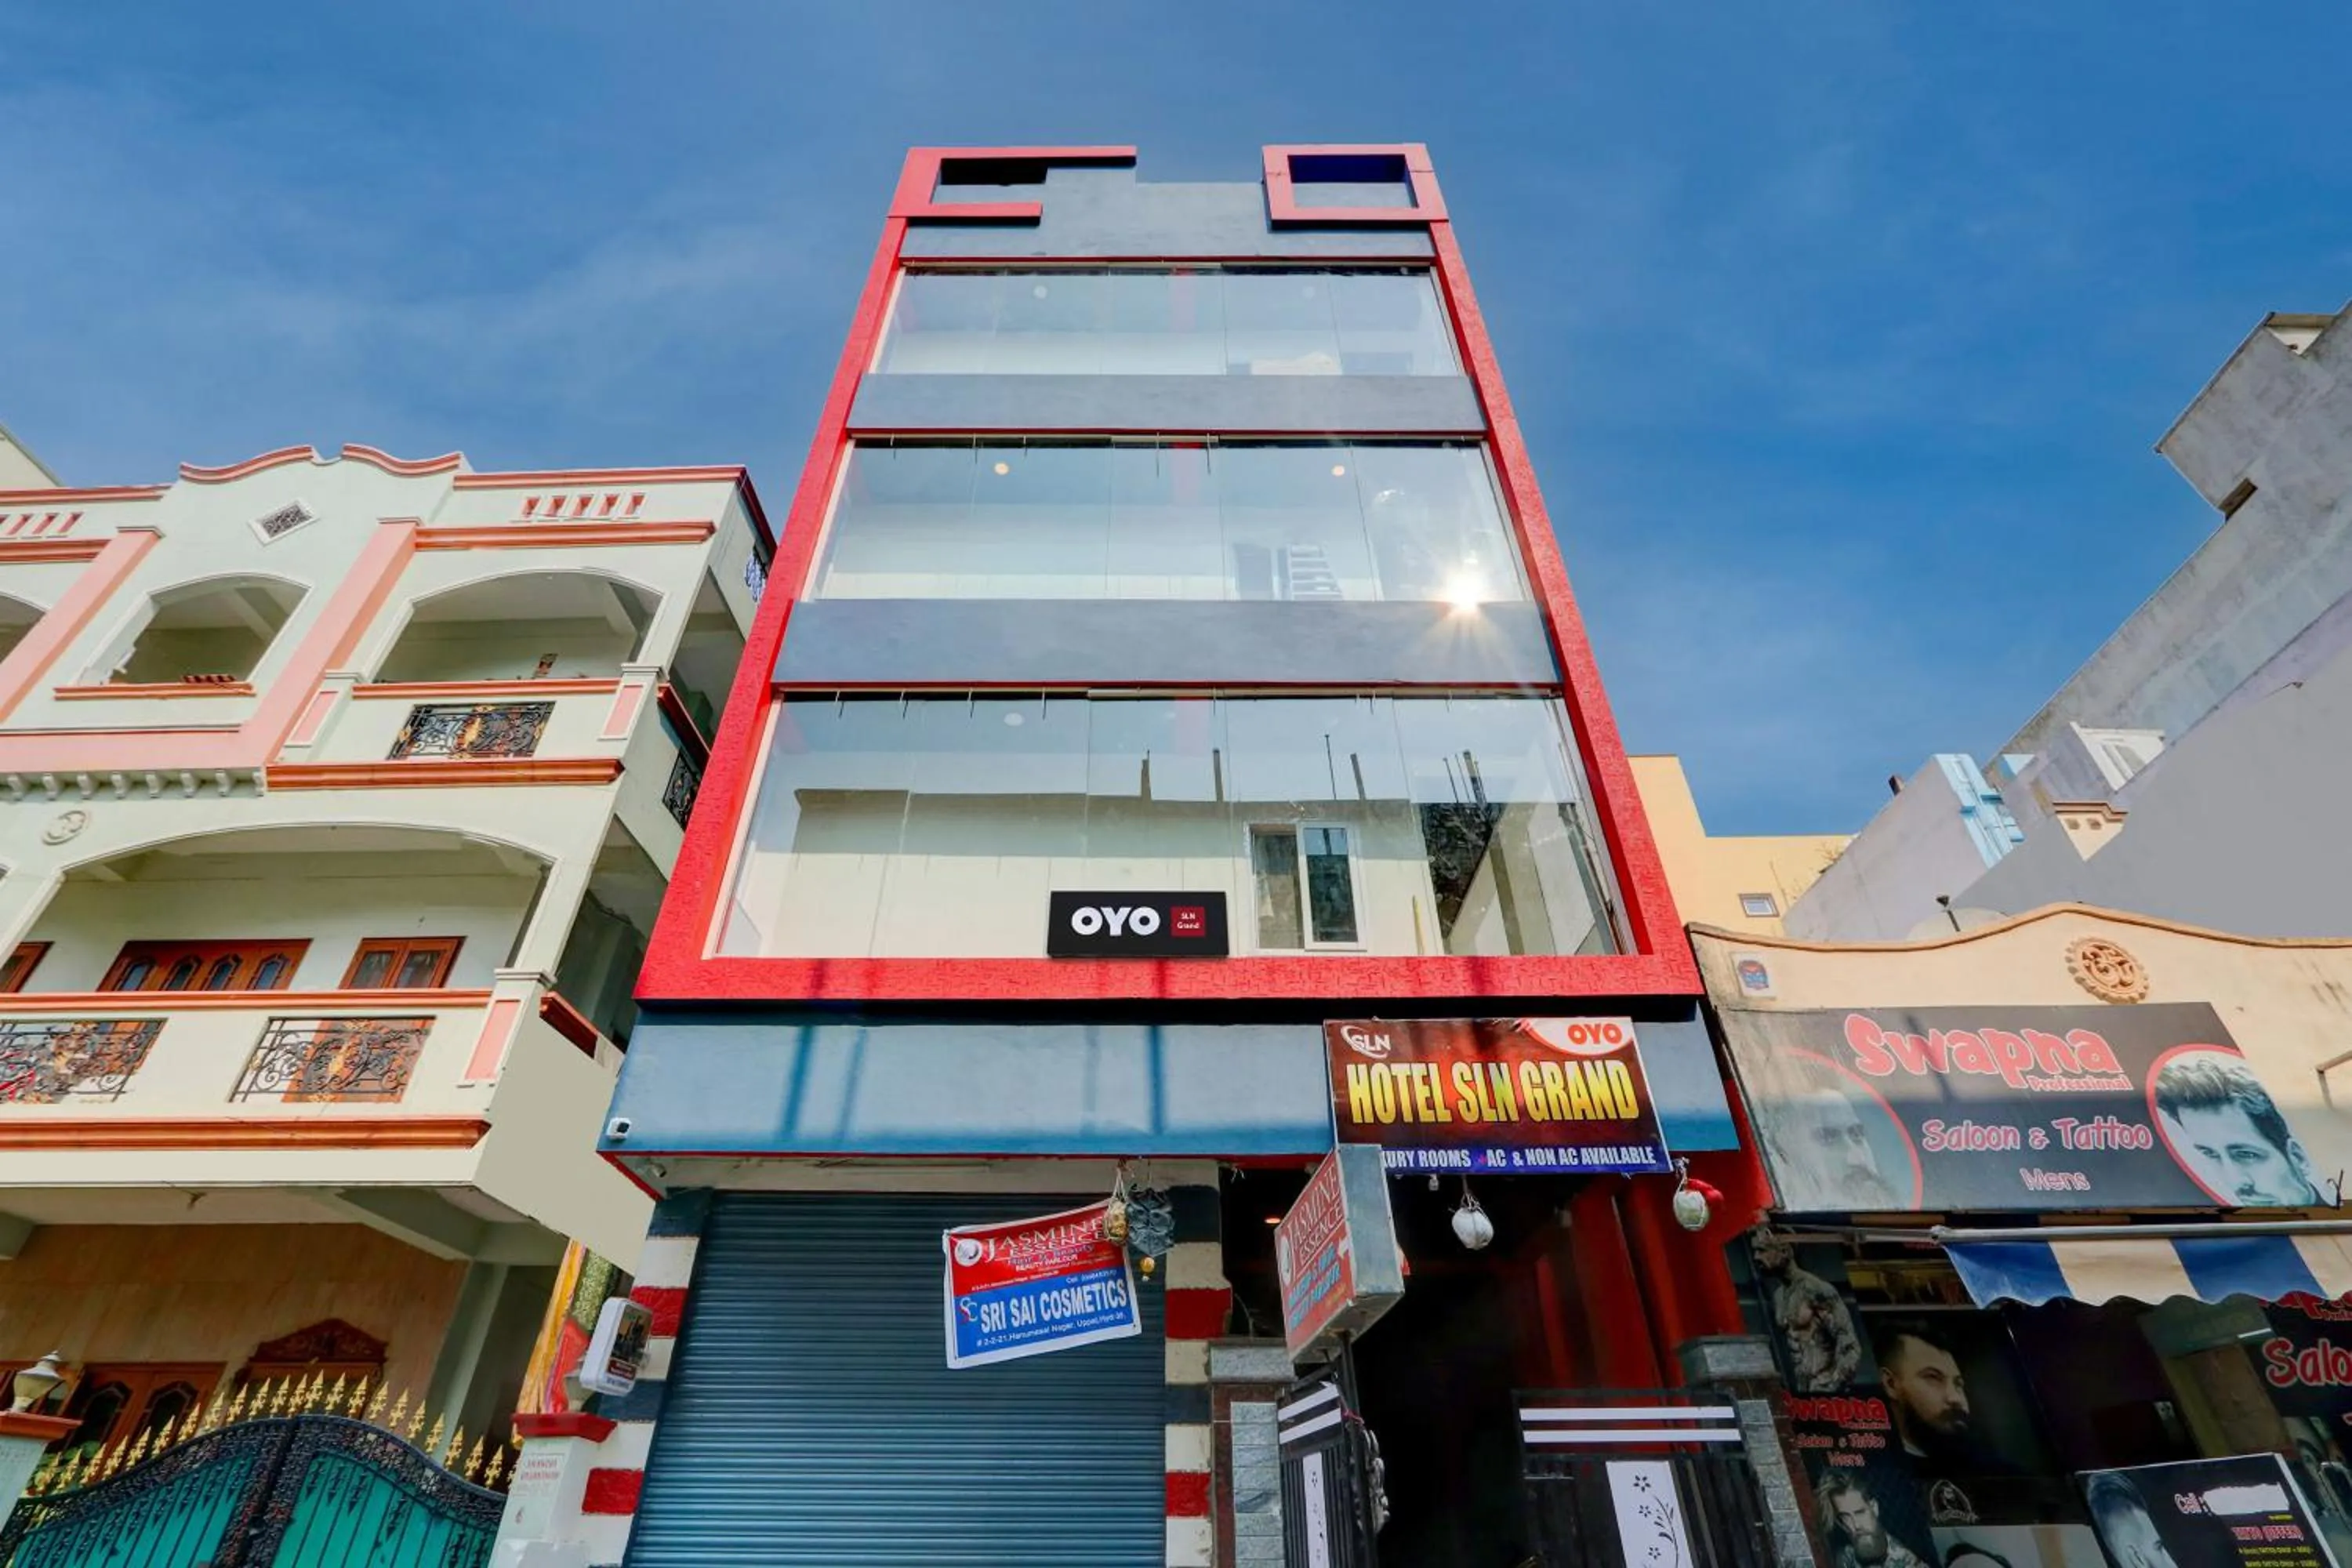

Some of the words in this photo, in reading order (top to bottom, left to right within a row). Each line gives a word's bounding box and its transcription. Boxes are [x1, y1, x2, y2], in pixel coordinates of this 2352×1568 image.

[1071, 906, 1160, 936] OYO
[1350, 1033, 1392, 1051] SLN
[1567, 1024, 1622, 1045] OYO
[1845, 1014, 2124, 1089] Swapna
[1345, 1062, 1452, 1123] HOTEL
[1453, 1061, 1519, 1123] SLN
[1519, 1060, 1640, 1123] GRAND
[2027, 1075, 2133, 1091] Professional
[1922, 1119, 2020, 1152] Saloon
[2029, 1127, 2049, 1150] &
[2052, 1116, 2154, 1151] Tattoo
[1418, 1150, 1471, 1167] ROOMS
[1487, 1149, 1506, 1167] AC
[1513, 1152, 1524, 1167] &
[1525, 1149, 1557, 1166] NON
[1559, 1149, 1578, 1166] AC
[1580, 1146, 1657, 1165] AVAILABLE
[2020, 1168, 2091, 1191] Mens
[1287, 1163, 1340, 1278] JASMINE
[980, 1301, 1007, 1333] SRI
[1009, 1296, 1036, 1327] SAI
[1040, 1279, 1127, 1321] COSMETICS
